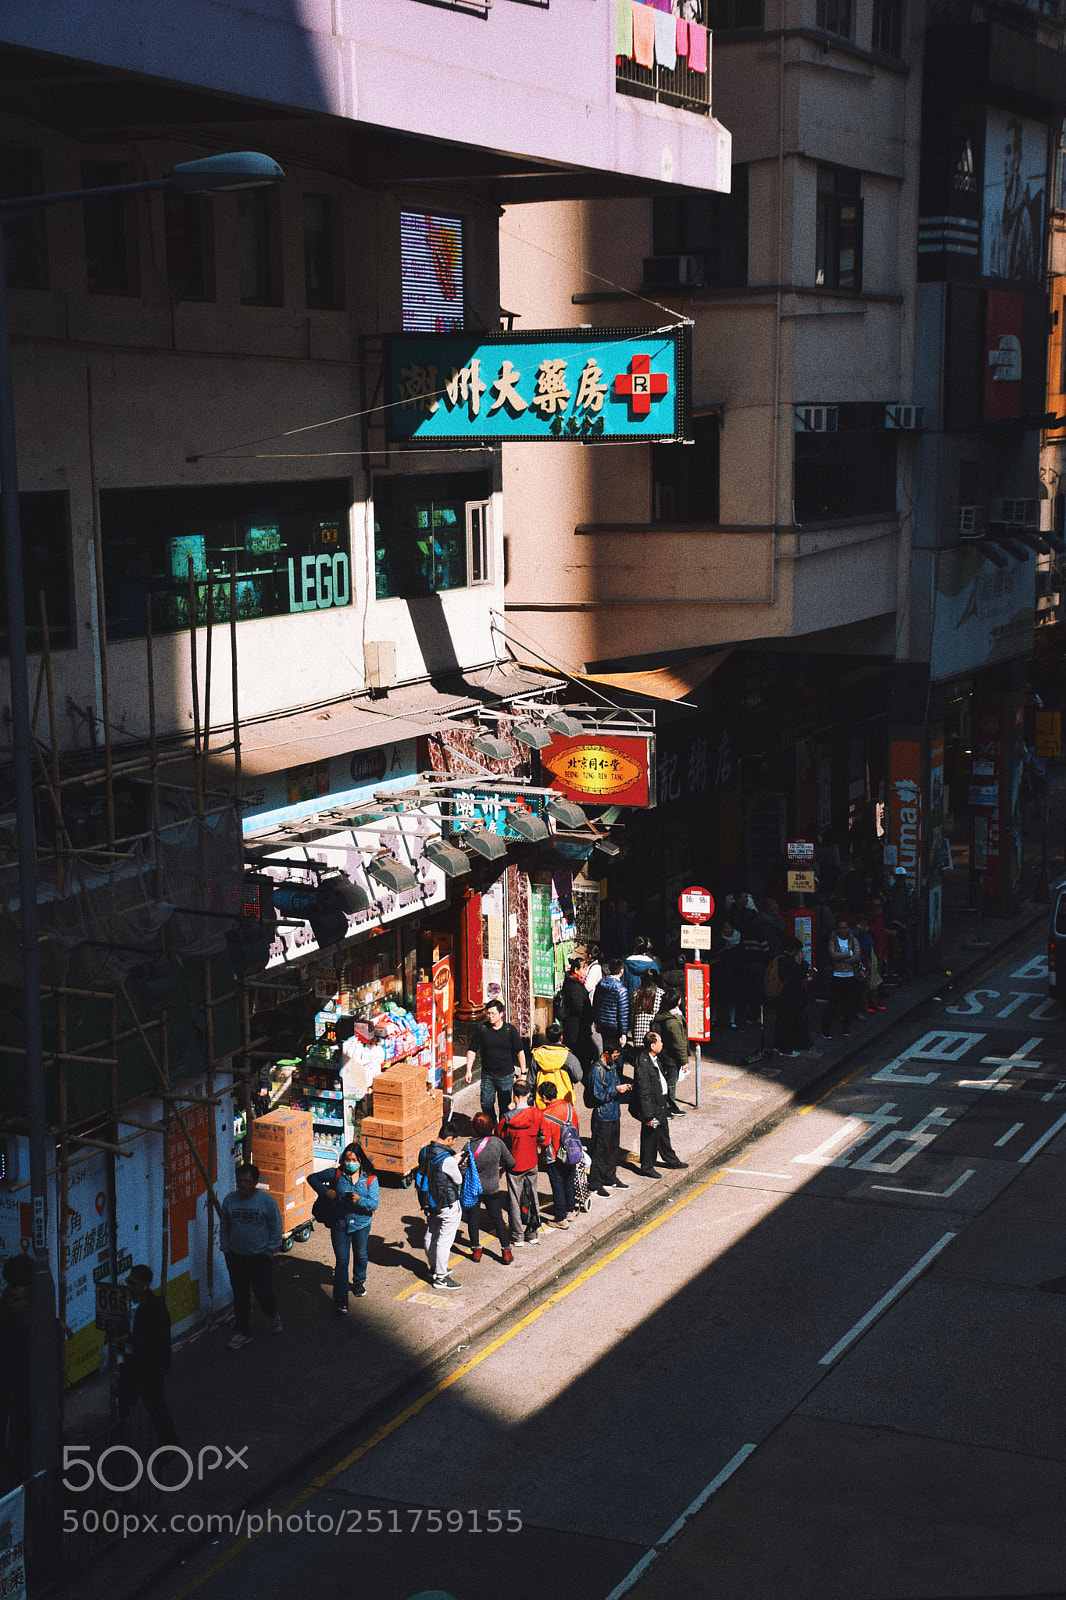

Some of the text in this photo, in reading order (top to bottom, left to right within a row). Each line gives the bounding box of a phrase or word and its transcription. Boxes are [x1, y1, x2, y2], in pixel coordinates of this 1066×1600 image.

[397, 358, 608, 414] 潮州大藥房
[288, 552, 349, 613] LEGO
